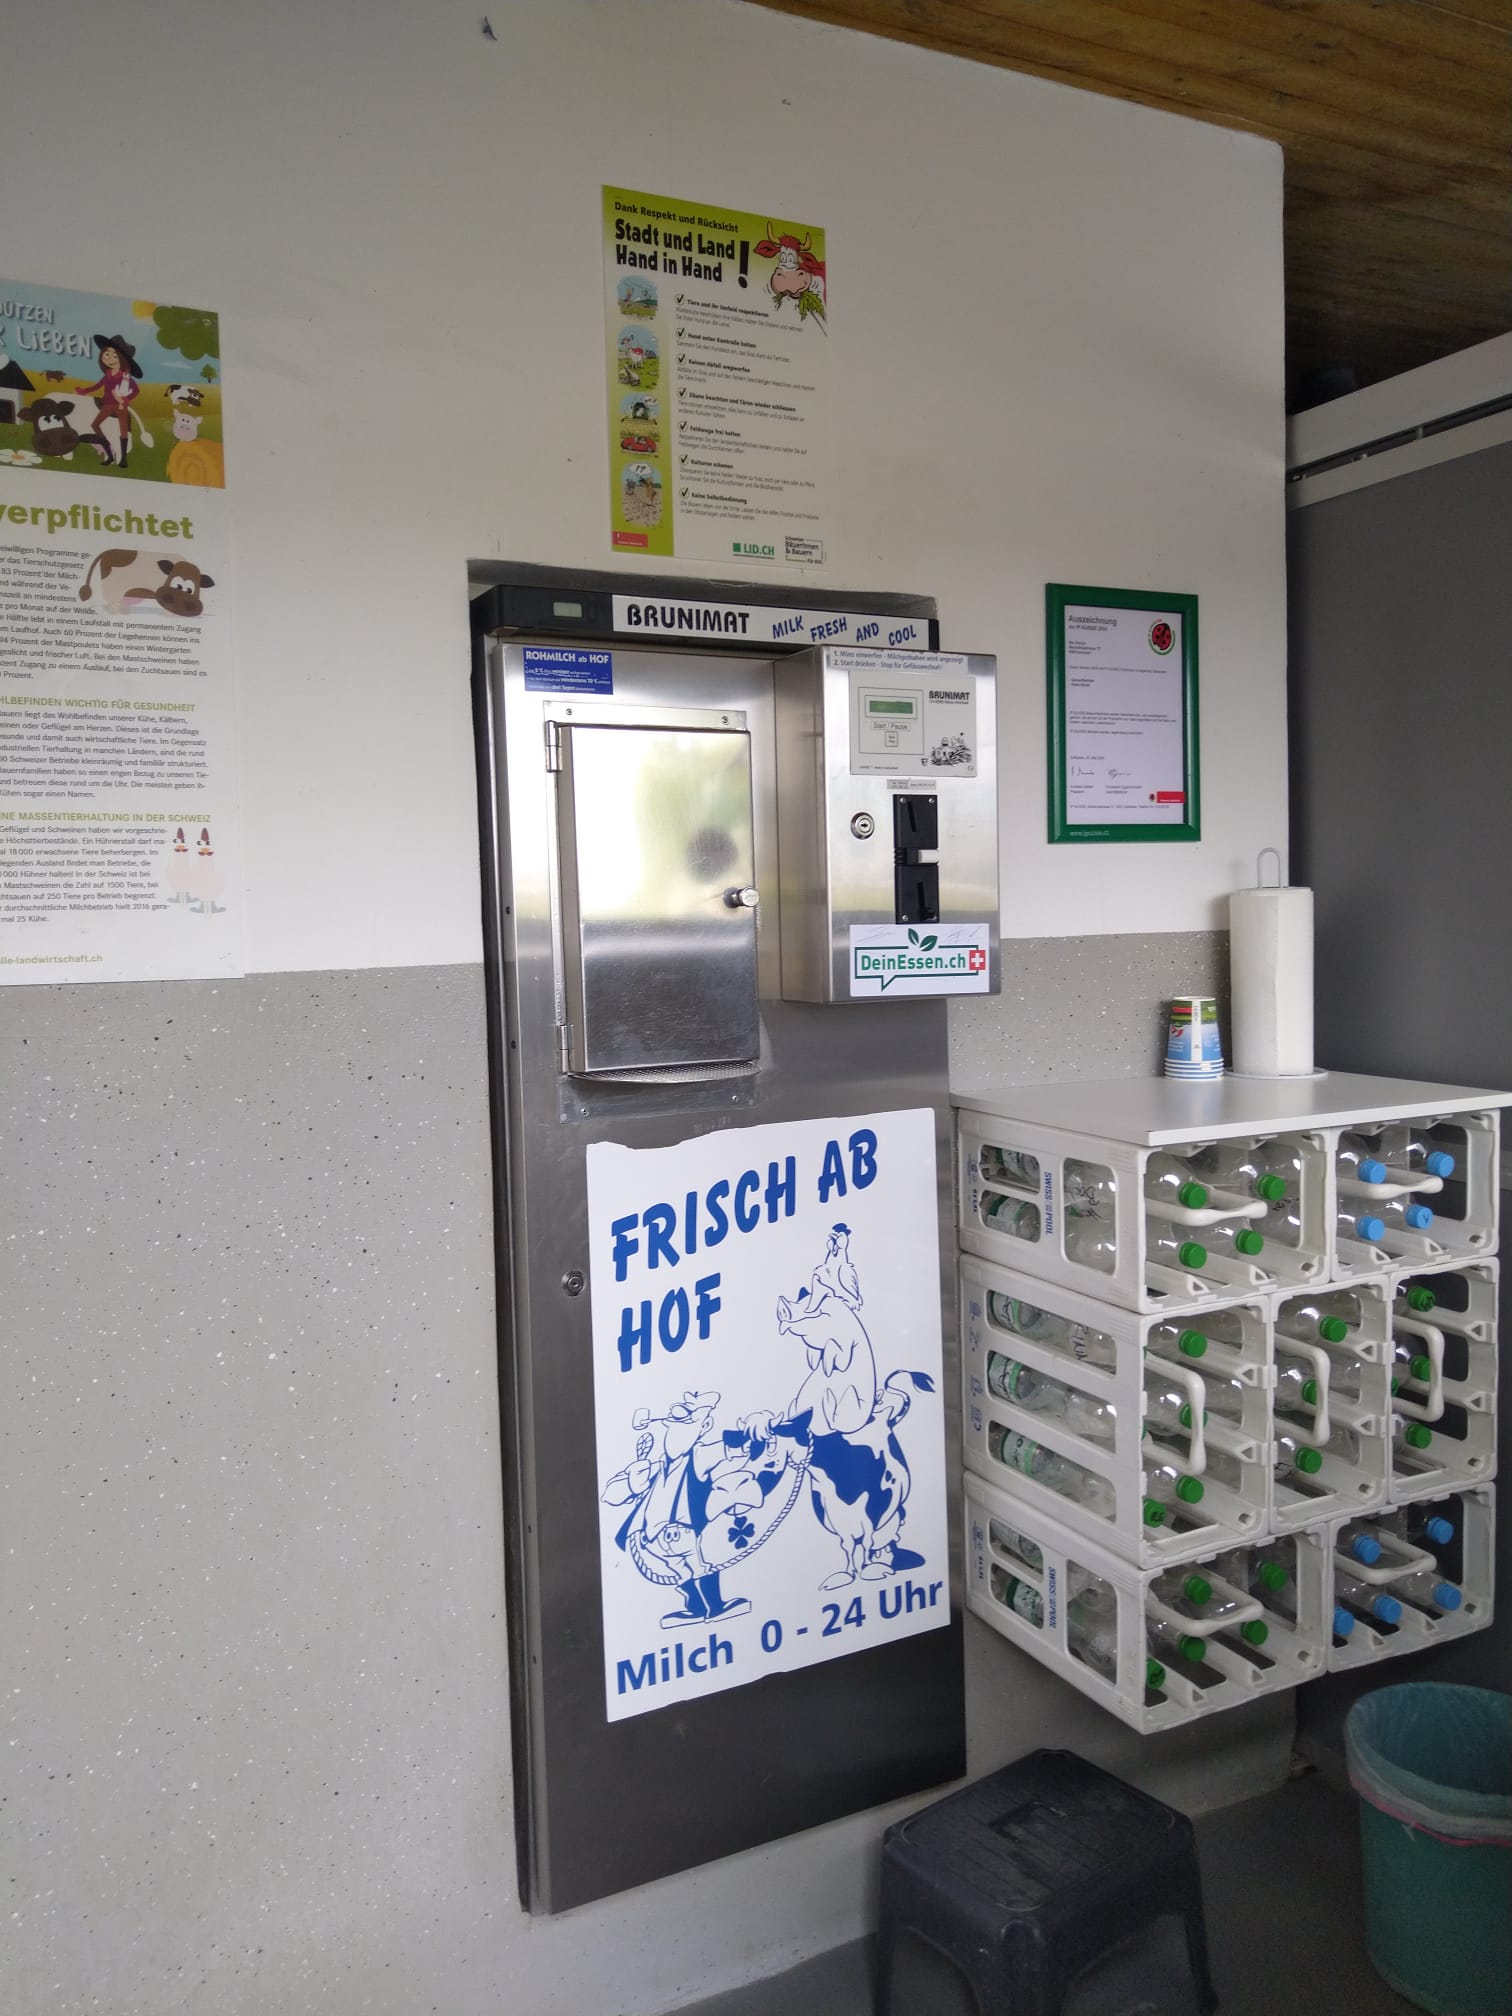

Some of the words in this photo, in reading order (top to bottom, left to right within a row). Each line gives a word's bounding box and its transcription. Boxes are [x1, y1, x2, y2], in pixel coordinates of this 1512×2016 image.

[615, 202, 638, 214] Dank
[641, 207, 676, 222] Respekt
[679, 212, 695, 224] und
[698, 217, 738, 232] Rücksicht
[615, 218, 660, 245] Stadt
[664, 232, 692, 252] und
[698, 234, 735, 260] Land
[738, 240, 750, 288] !
[616, 244, 658, 270] Hand
[664, 253, 678, 274] in
[682, 256, 722, 282] Hand
[744, 543, 775, 556] LID.CH
[1, 565, 12, 575] 83
[13, 568, 42, 577] Prozent
[19, 602, 44, 611] Monat
[628, 604, 749, 634] BRUNIMAT
[772, 615, 805, 640] MILK
[810, 616, 848, 641] FRESH
[856, 622, 880, 642] AND
[888, 628, 917, 646] COOL
[1068, 615, 1117, 627] Auszeichnung
[10, 637, 39, 645] Prozent
[101, 640, 124, 650] haben
[526, 651, 575, 662] ROHMILCH
[589, 655, 609, 664] HOF
[887, 653, 925, 661] Milchguthaben
[929, 690, 970, 700] BRUNIMAT
[65, 699, 108, 708] WICHTIG
[110, 700, 131, 709] FÜR
[133, 702, 194, 712] GESUNDHEIT
[57, 712, 107, 720] Wohlbefinden
[53, 766, 77, 775] haben
[67, 790, 96, 798] Namen.
[19, 812, 130, 821] MASSENTIERHALTUNG
[132, 814, 143, 822] IN
[146, 813, 165, 822] DER
[168, 814, 211, 822] SCHWEIZ
[98, 869, 127, 878] Schweiz
[139, 868, 151, 878] bei
[75, 880, 91, 888] Zahl
[107, 879, 125, 888] 1500
[96, 892, 123, 900] Betrieb
[16, 913, 27, 923] 25
[861, 954, 966, 970] DeinEssen.ch
[612, 1156, 796, 1282] FRISCH
[818, 1128, 878, 1204] AB
[618, 1272, 721, 1372] HOF
[616, 1633, 734, 1695] Milch
[761, 1619, 783, 1653] 0
[796, 1627, 808, 1635] -
[821, 1596, 866, 1638] 24
[879, 1580, 943, 1620] Uhr
